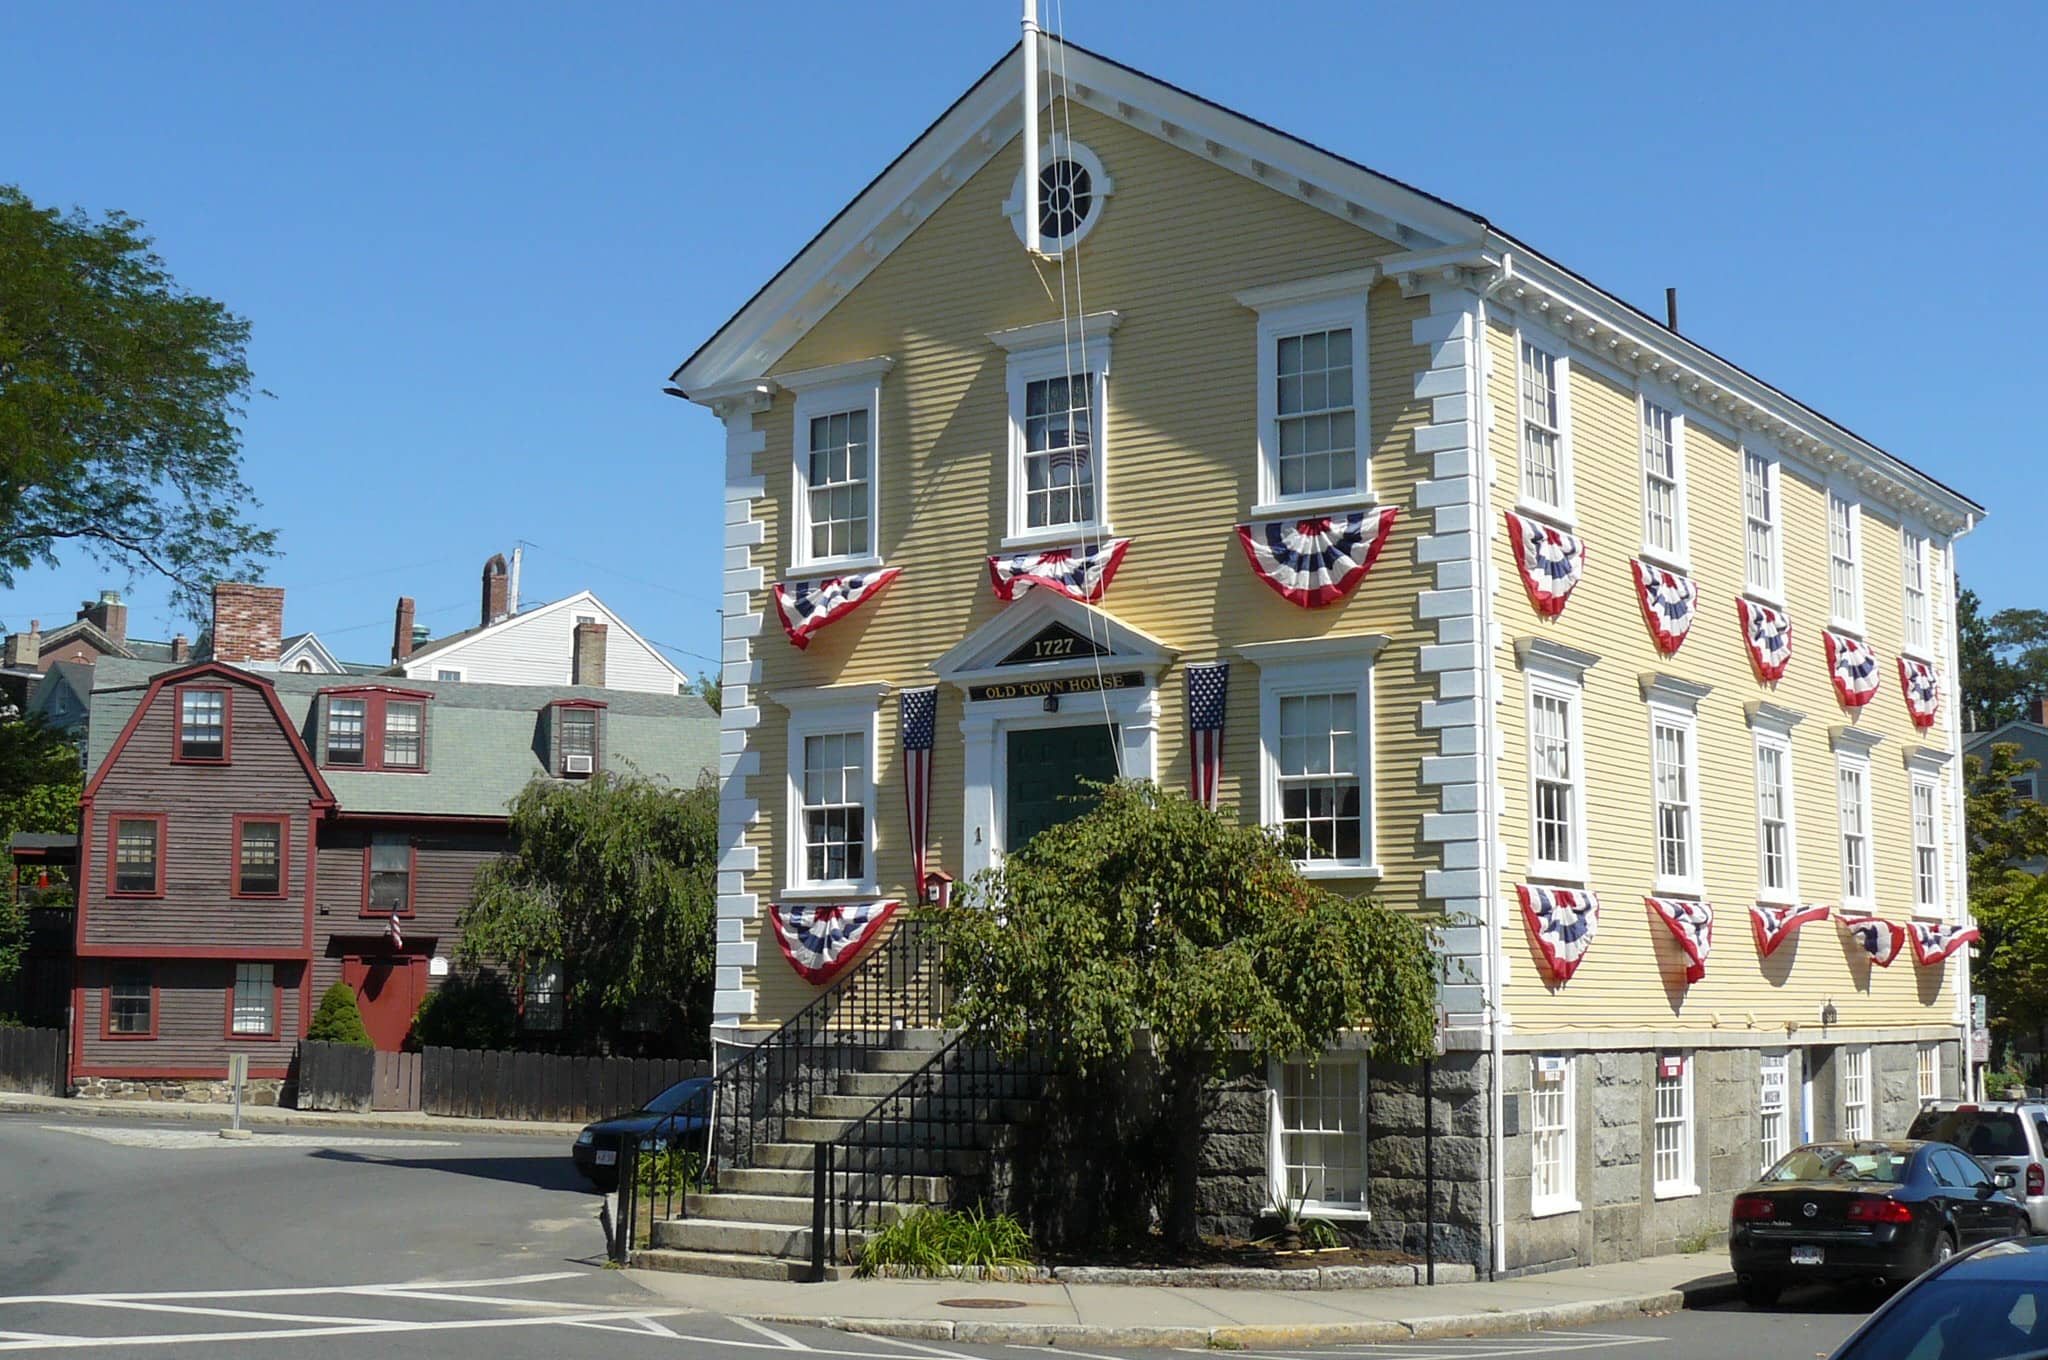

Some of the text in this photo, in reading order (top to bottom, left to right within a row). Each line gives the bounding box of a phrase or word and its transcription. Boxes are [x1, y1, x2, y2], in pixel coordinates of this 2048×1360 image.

[1035, 638, 1074, 656] 1727
[985, 675, 1125, 699] OLD TOWN HOUSE
